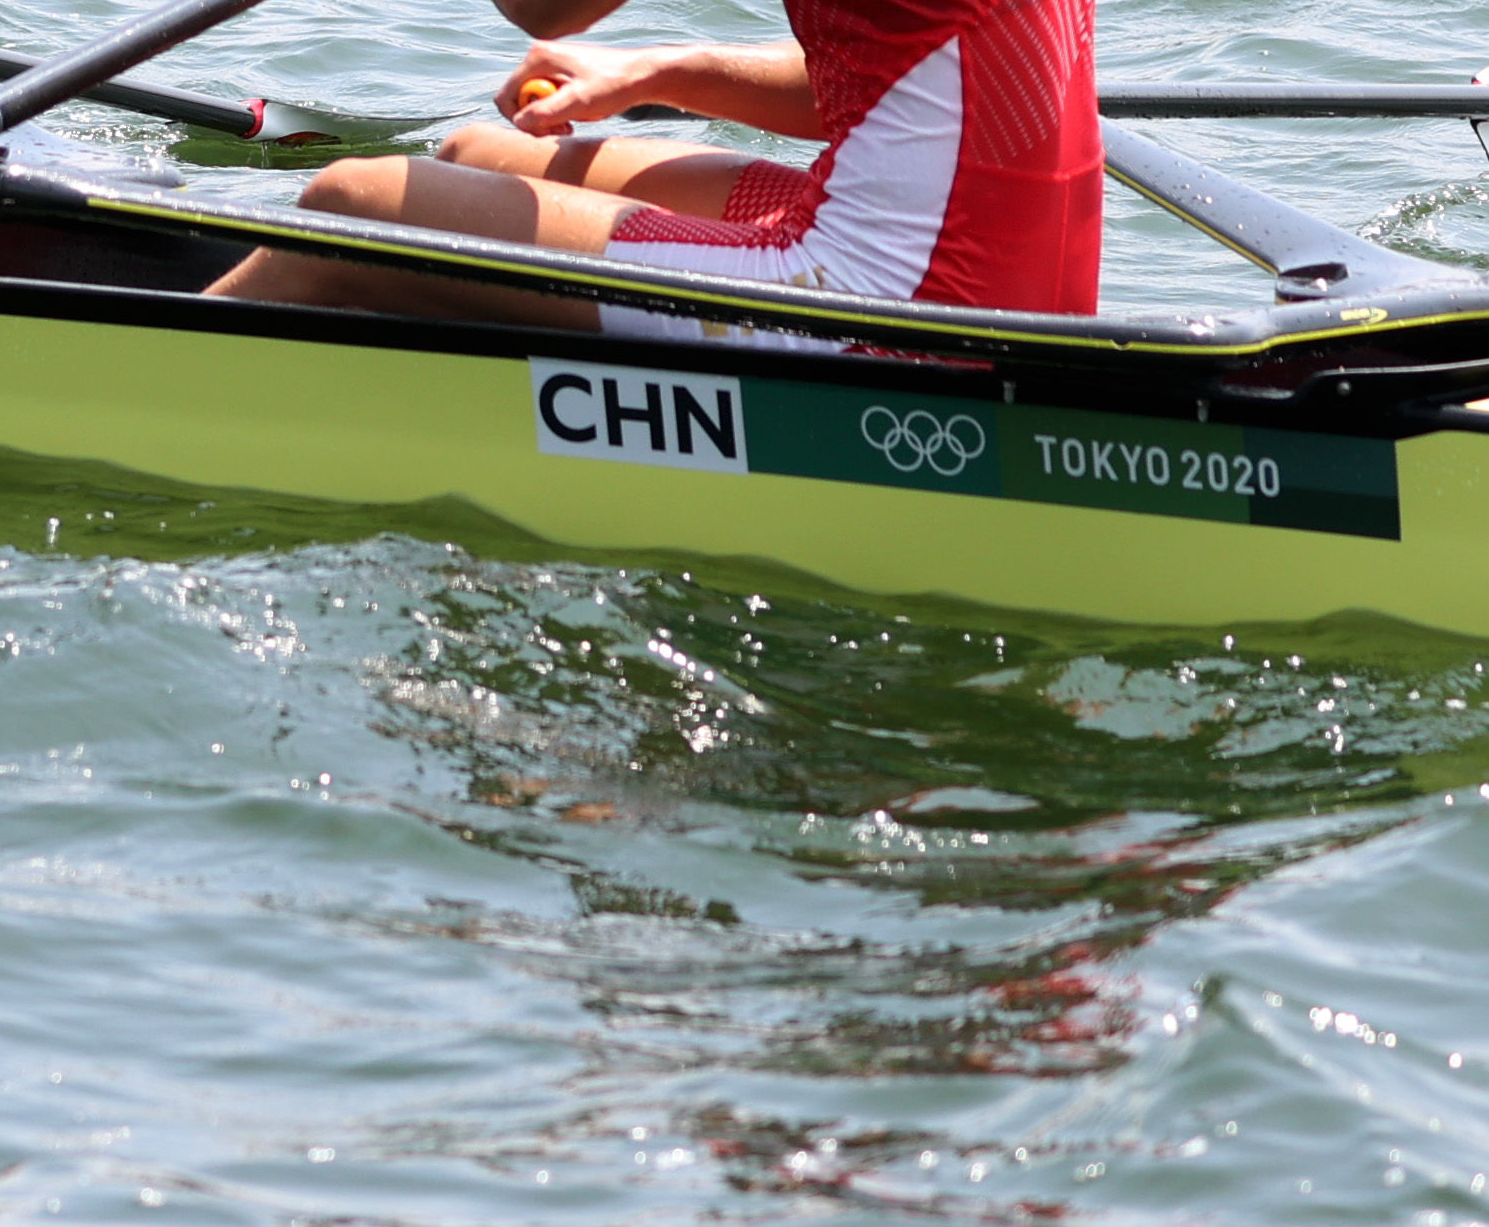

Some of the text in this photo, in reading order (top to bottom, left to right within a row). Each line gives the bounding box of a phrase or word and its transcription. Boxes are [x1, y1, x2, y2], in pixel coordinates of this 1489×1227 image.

[537, 373, 738, 460] CHN
[1034, 433, 1281, 499] TOKYO 2020
